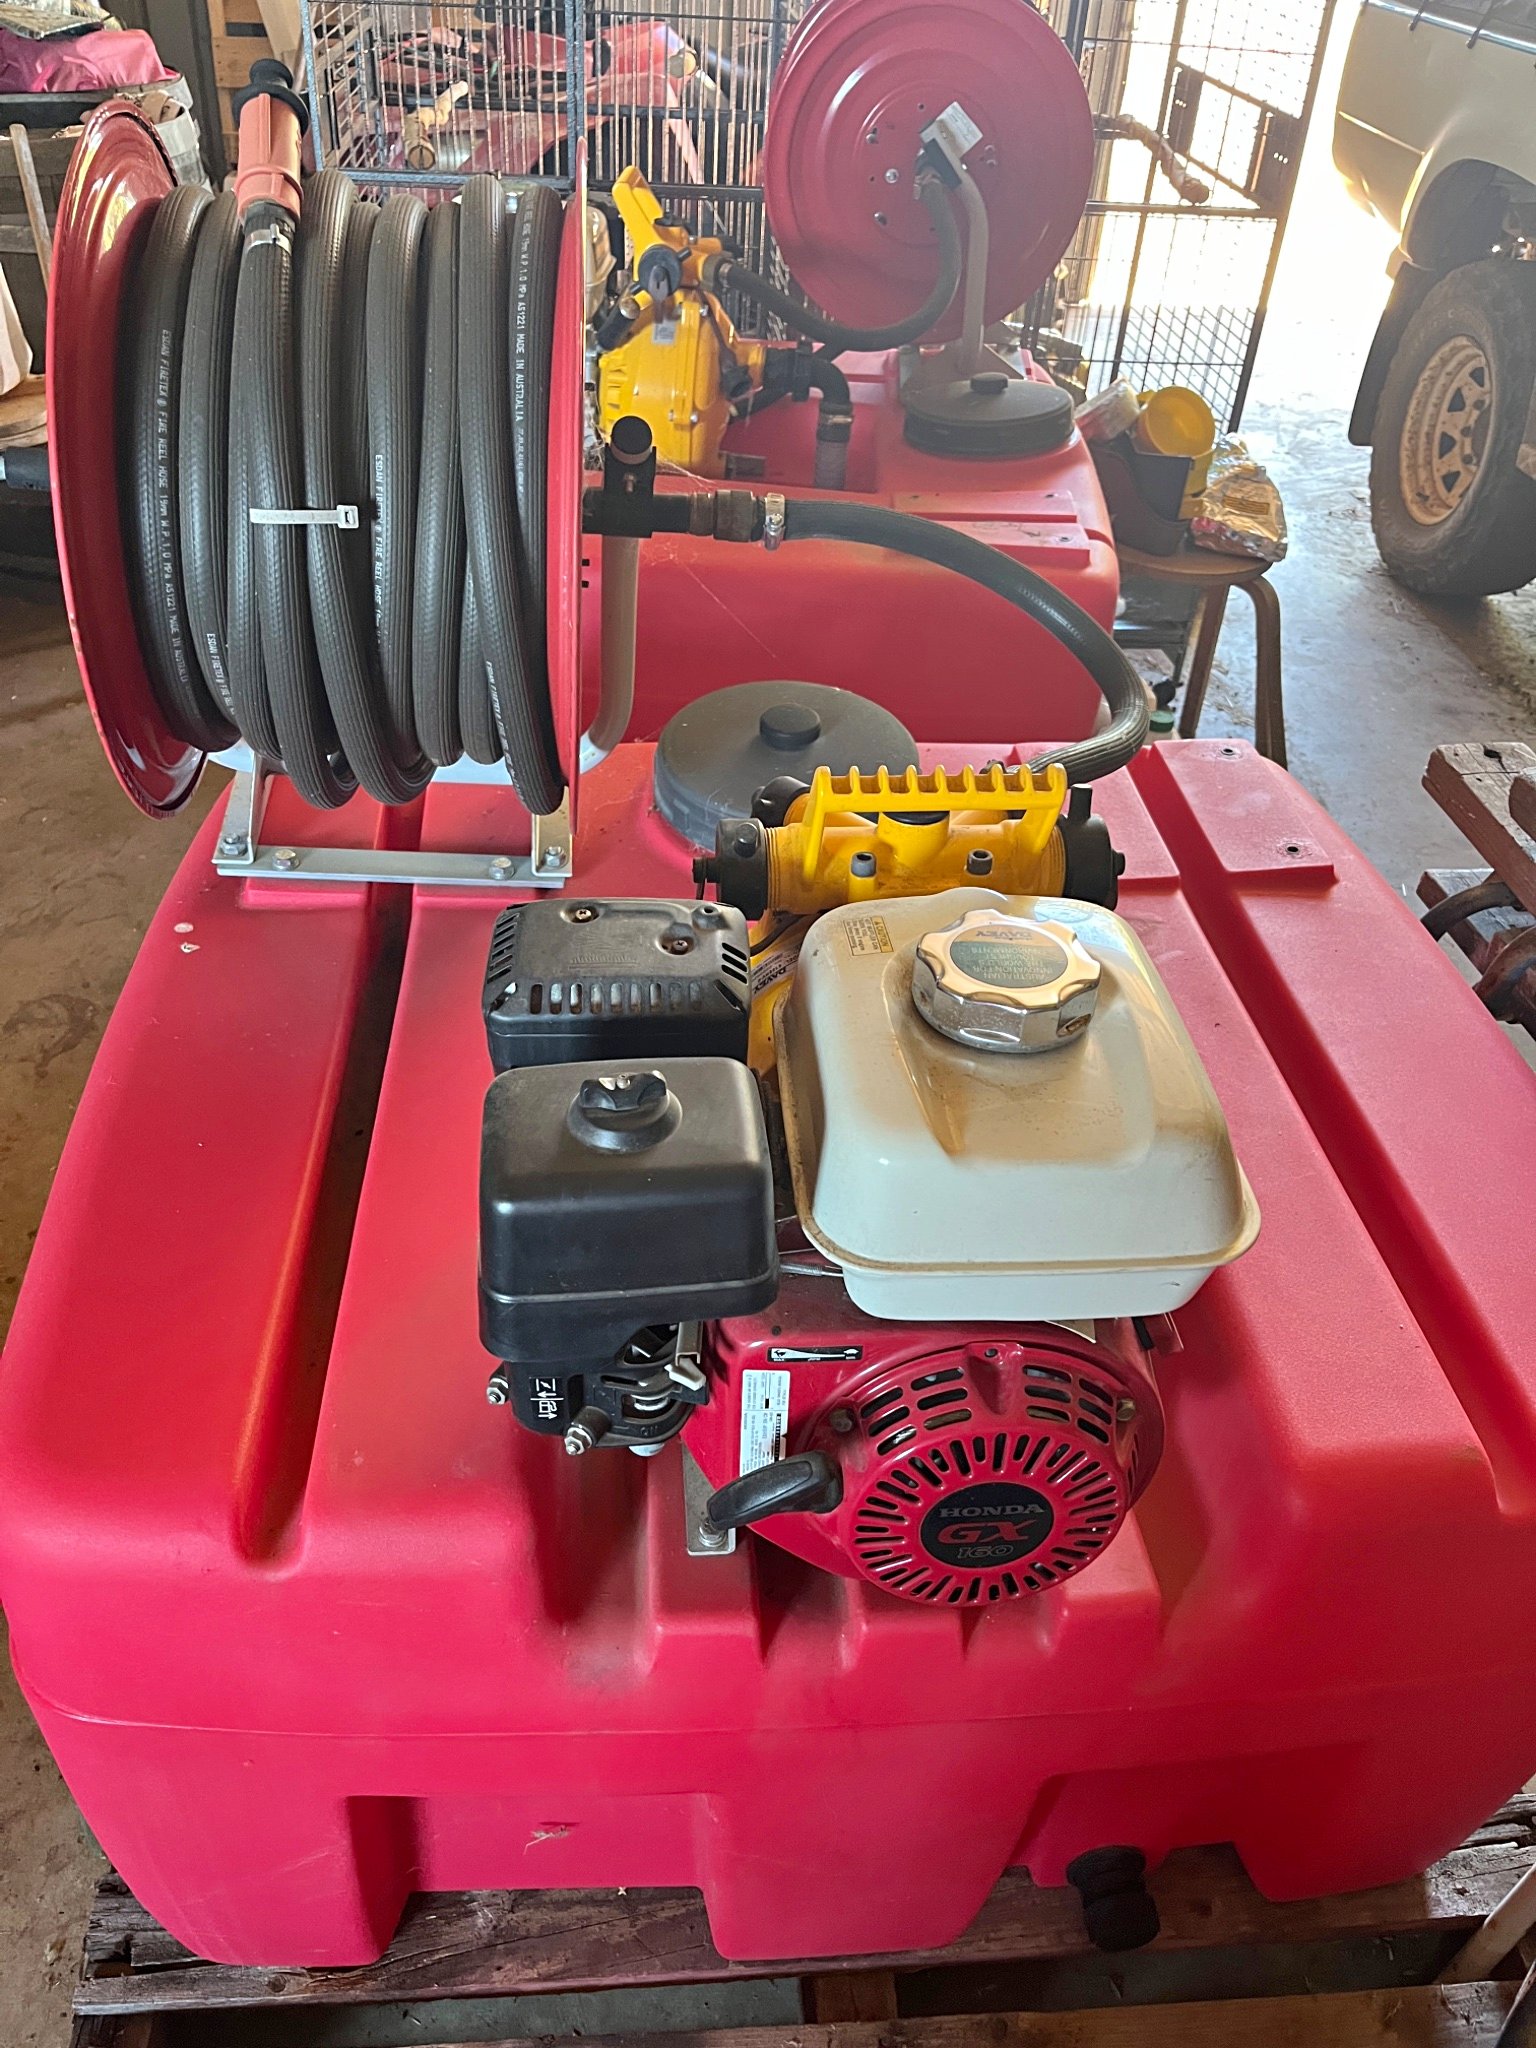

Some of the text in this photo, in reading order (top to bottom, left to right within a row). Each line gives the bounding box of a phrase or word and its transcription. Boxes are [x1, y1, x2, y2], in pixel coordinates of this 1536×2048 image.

[516, 302, 526, 329] AS1221
[516, 334, 525, 354] MADE
[516, 359, 525, 370] IN
[159, 359, 170, 398] FIRETEX
[515, 373, 525, 422] AUSTRALIA
[158, 411, 168, 434] FIRE
[158, 438, 168, 460] REEL
[158, 465, 168, 489] HOSE
[375, 454, 383, 483] ESDAN
[375, 536, 383, 558] FIRE
[374, 561, 382, 580] REEL
[165, 583, 177, 611] AS1221
[374, 585, 382, 605] HOSE
[169, 614, 180, 635] MADE
[206, 633, 218, 655] ESDAN
[976, 930, 1033, 938] DAVEY
[752, 966, 787, 994] DAVEY
[982, 972, 1045, 981] AUSTRALIAN
[940, 1504, 1045, 1518] HONDA
[938, 1519, 1037, 1544] GX
[957, 1545, 1014, 1559] 160
